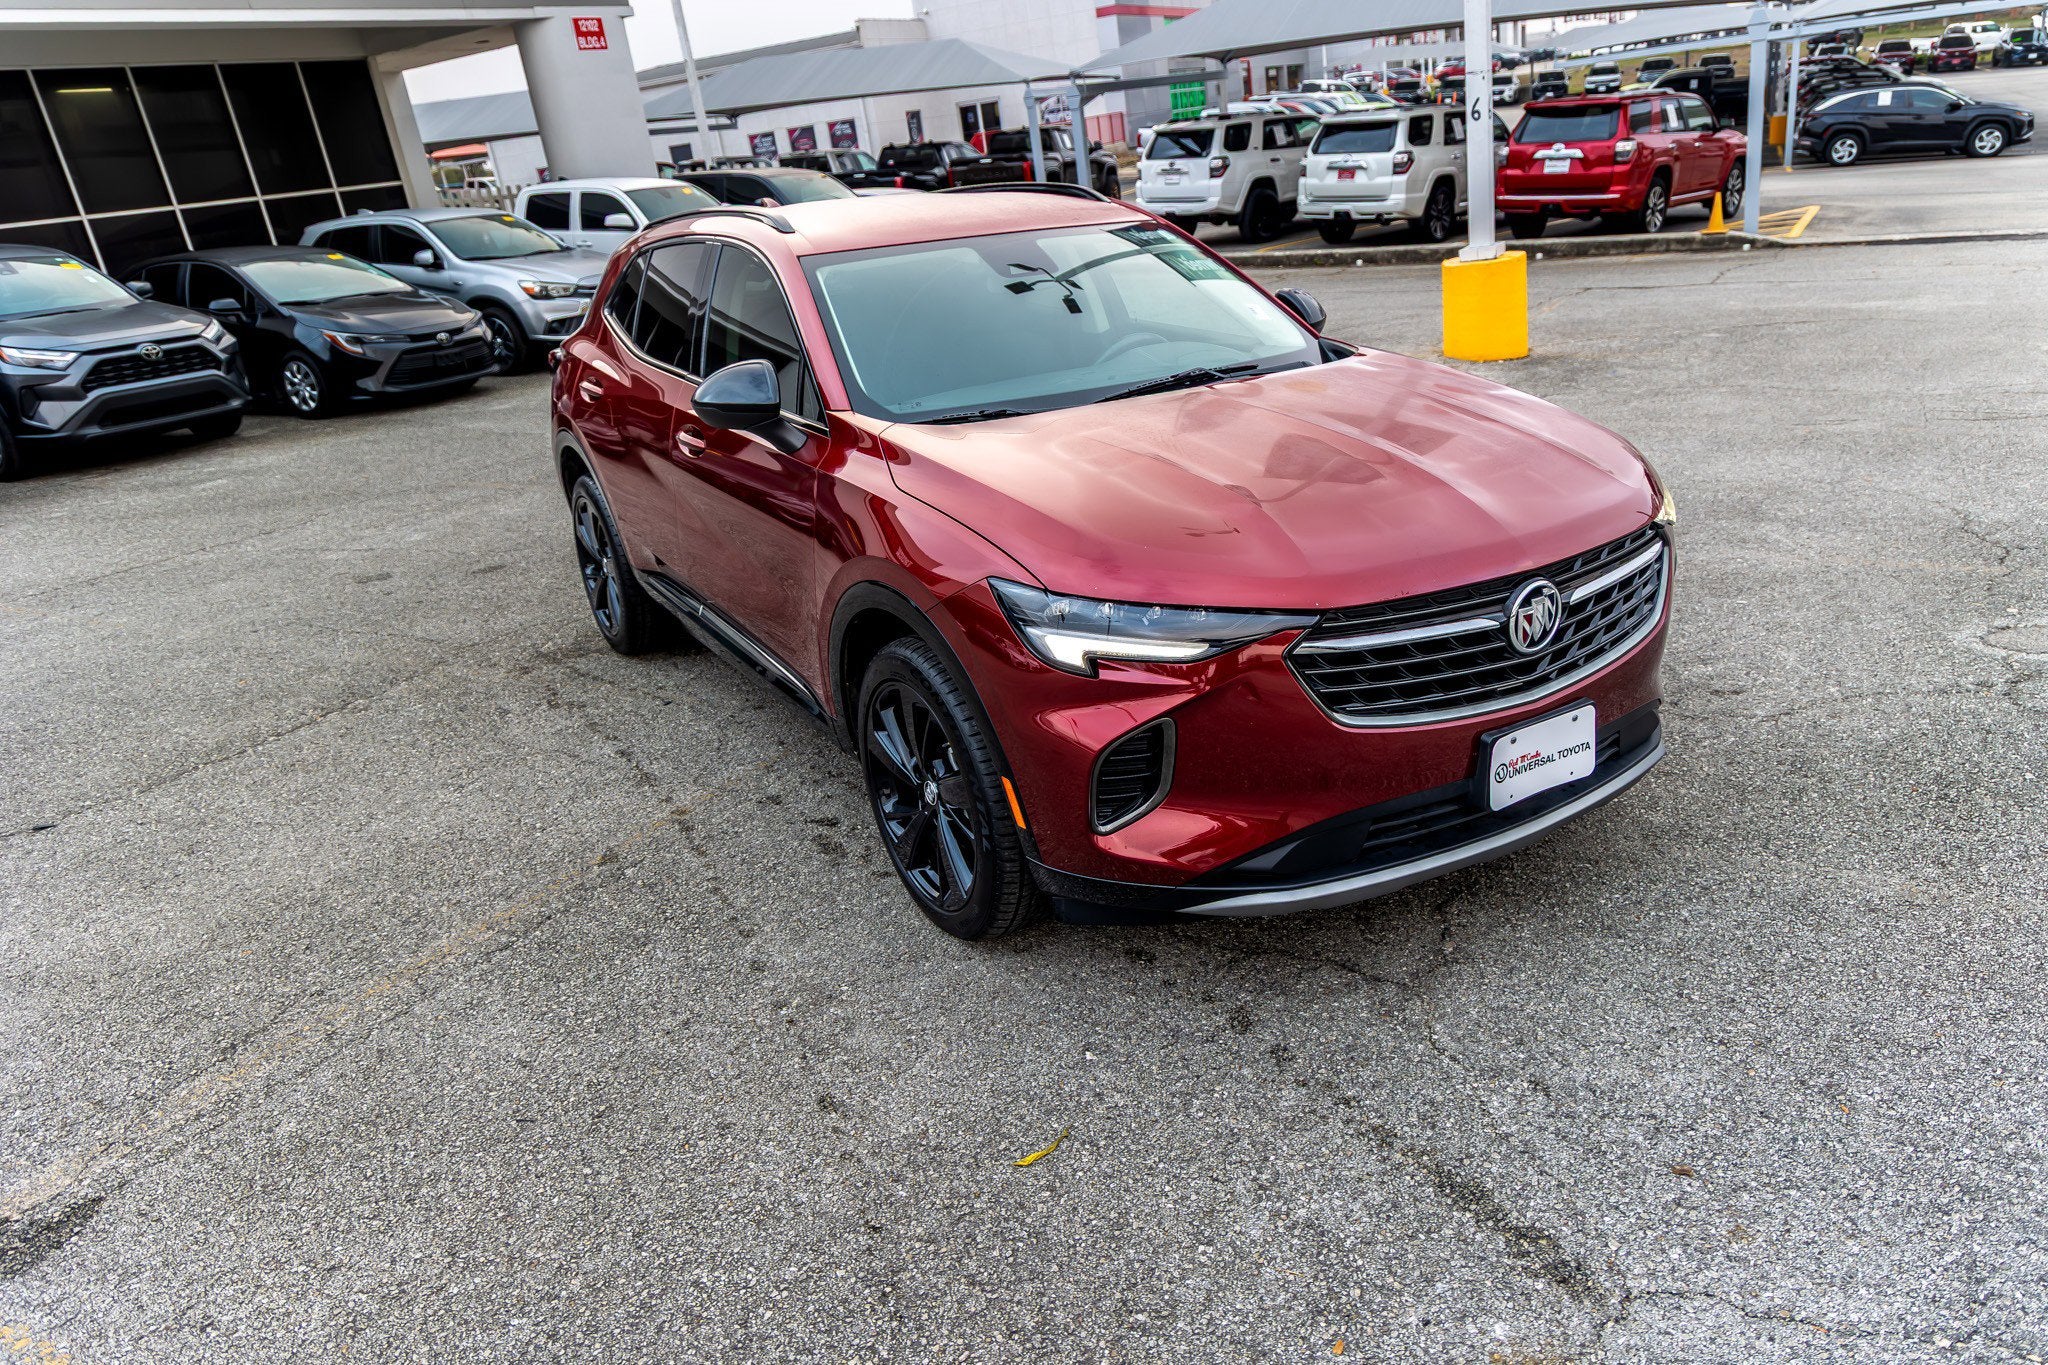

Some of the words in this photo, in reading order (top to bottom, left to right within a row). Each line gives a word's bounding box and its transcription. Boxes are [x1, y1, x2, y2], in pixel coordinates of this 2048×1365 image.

[1471, 97, 1481, 121] 6
[1508, 754, 1556, 779] UNIVERSAL
[1557, 741, 1591, 760] TOYOTA
